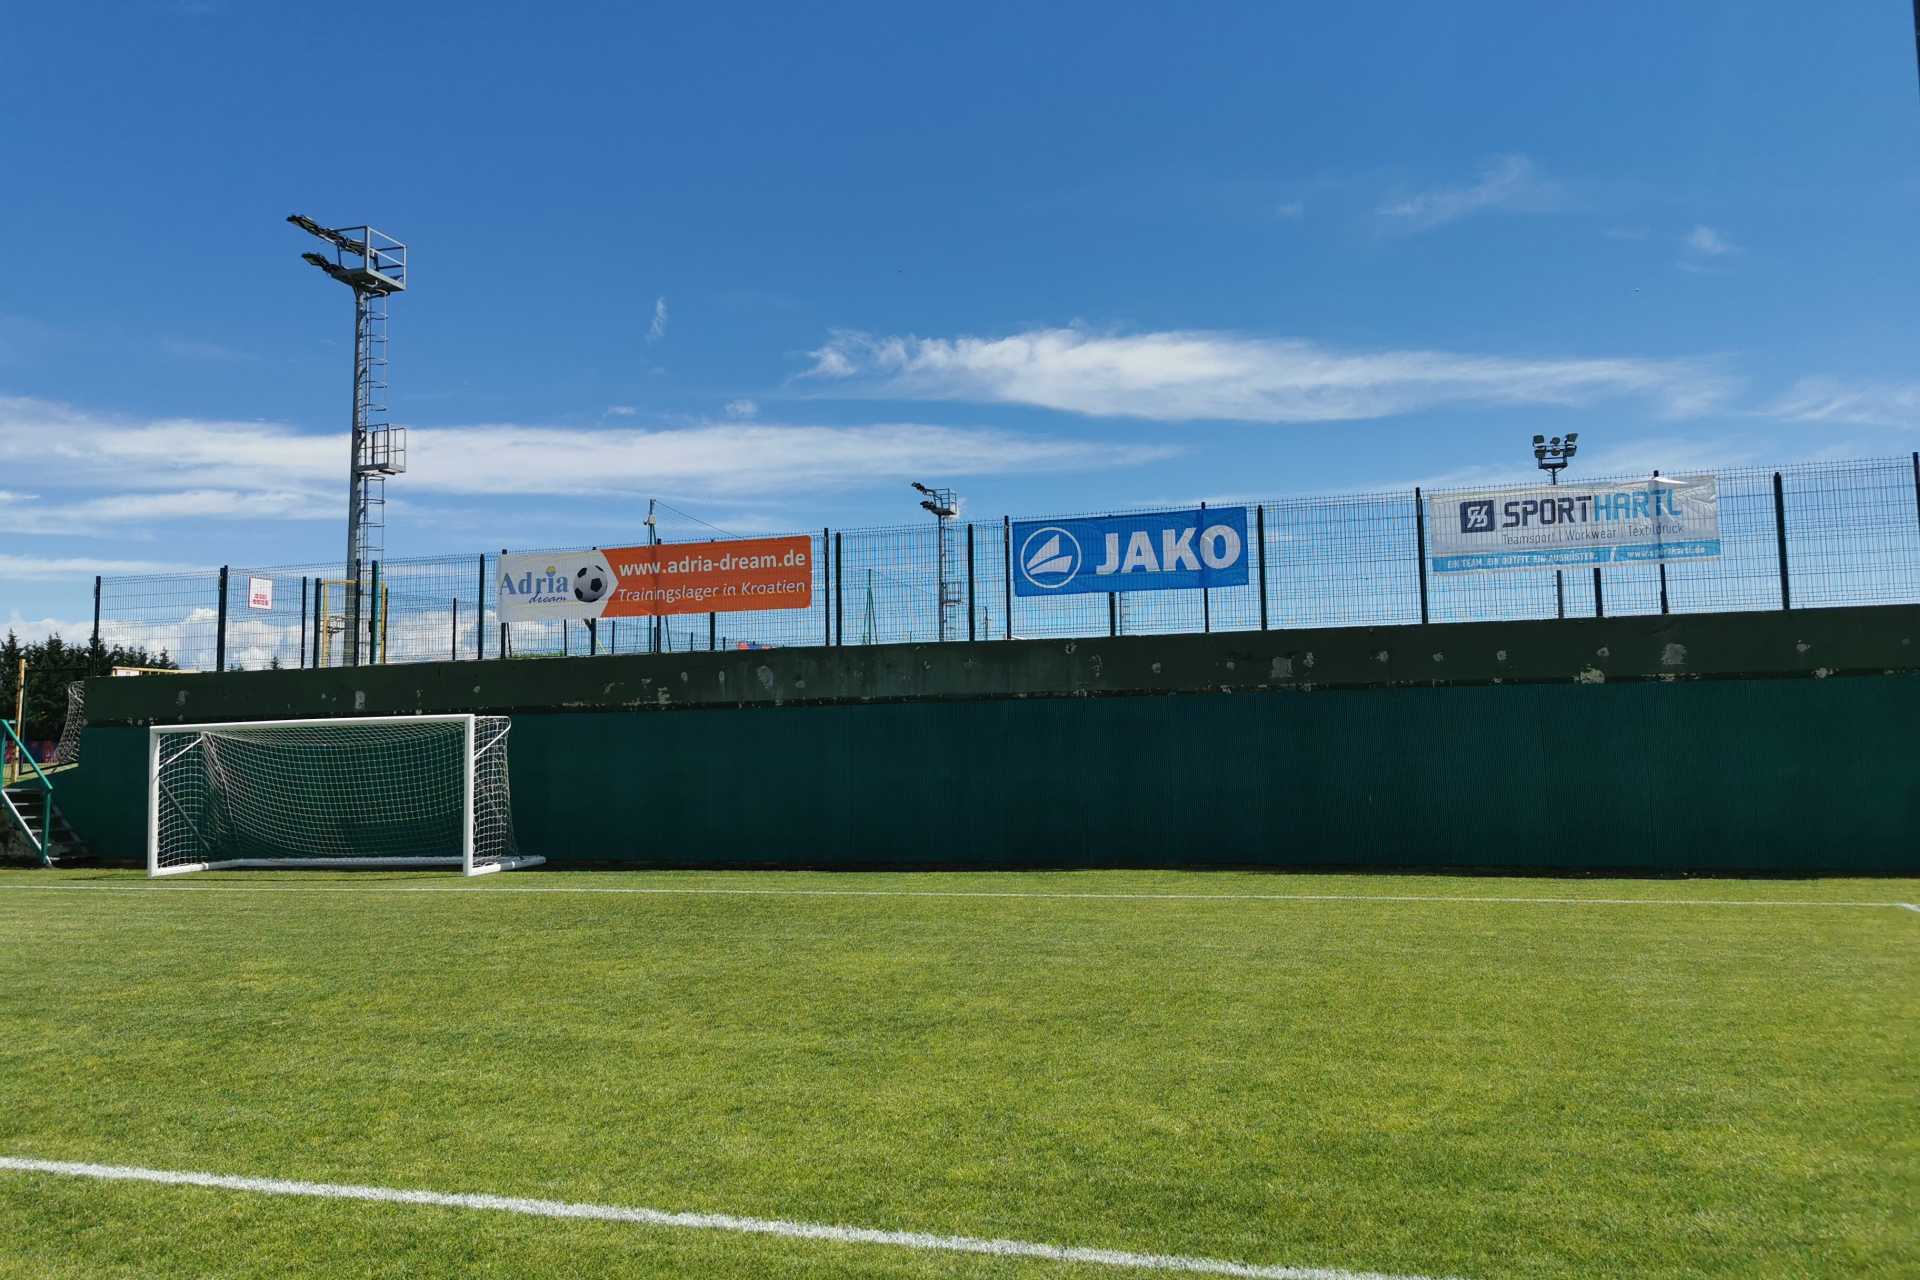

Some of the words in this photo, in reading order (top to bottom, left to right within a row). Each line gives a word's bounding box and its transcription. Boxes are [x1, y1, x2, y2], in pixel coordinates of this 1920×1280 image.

[1503, 532, 1555, 545] Teamsport
[1566, 528, 1617, 542] Workwear
[1096, 524, 1241, 575] JAKO
[619, 550, 806, 577] www.adria-dream.de
[499, 567, 568, 595] Adria
[619, 586, 719, 604] Trainingslager
[724, 583, 736, 595] in
[741, 580, 806, 594] Kroatien
[528, 592, 567, 605] dream
